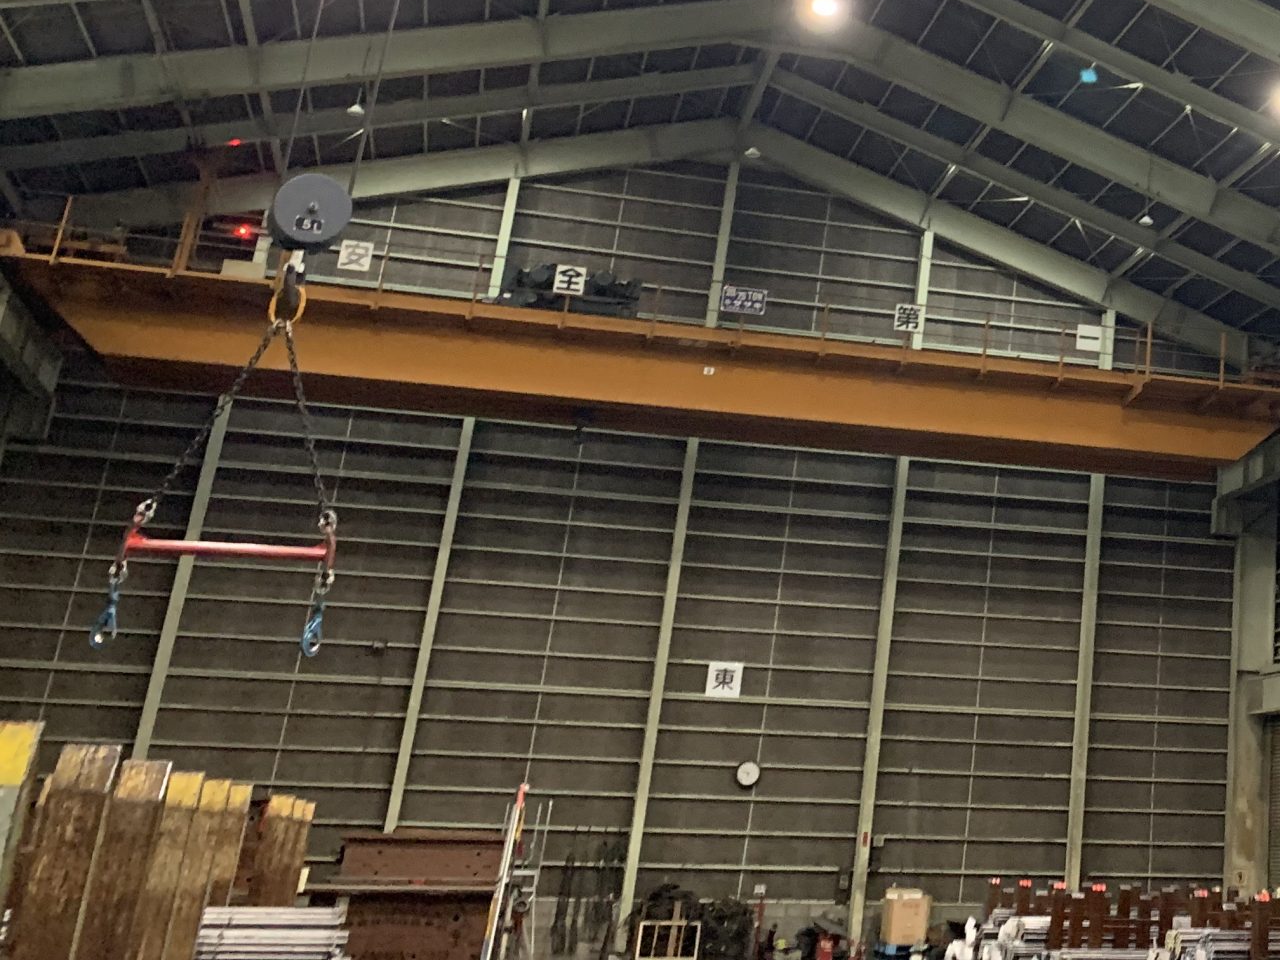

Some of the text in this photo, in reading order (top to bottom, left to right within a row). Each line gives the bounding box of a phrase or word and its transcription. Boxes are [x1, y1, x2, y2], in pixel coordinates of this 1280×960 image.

[341, 243, 370, 268] 安
[555, 268, 584, 293] 全
[896, 306, 919, 330] 第
[712, 668, 736, 691] 東
